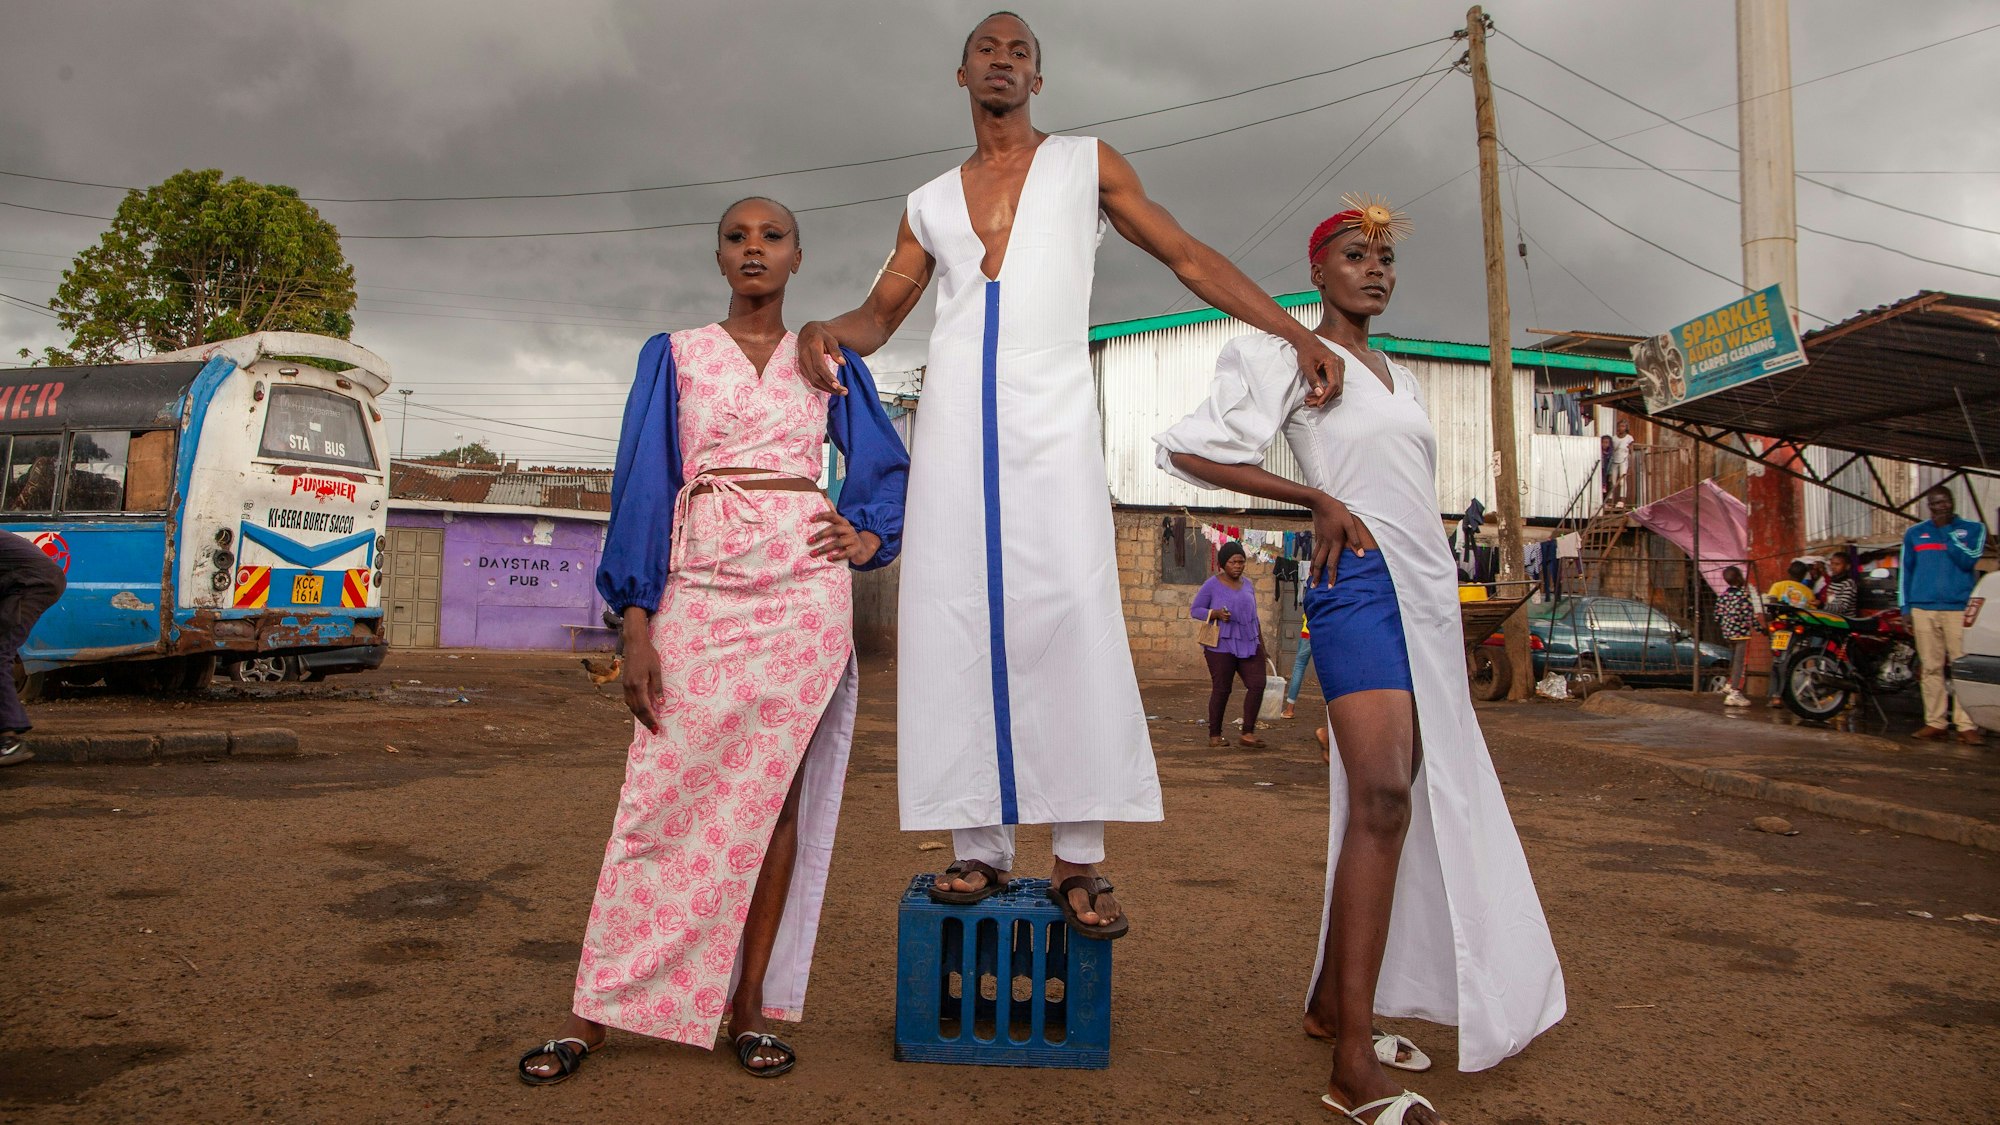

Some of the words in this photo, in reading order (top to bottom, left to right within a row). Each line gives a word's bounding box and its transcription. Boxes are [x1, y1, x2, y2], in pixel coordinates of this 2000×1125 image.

[1682, 292, 1770, 349] SPARKLE
[1688, 338, 1723, 365] AUTO
[1725, 319, 1773, 350] WASH
[1690, 364, 1699, 376] &
[1699, 352, 1729, 373] CARPET
[1729, 336, 1777, 363] CLEANING
[289, 434, 310, 451] STA
[324, 440, 346, 457] BUS
[291, 476, 356, 503] PUNISHER
[303, 511, 331, 531] BURET
[329, 514, 355, 534] SACCO
[559, 560, 570, 572] 2
[296, 577, 315, 590] KCC
[509, 575, 539, 587] PUB
[295, 589, 319, 603] 161A
